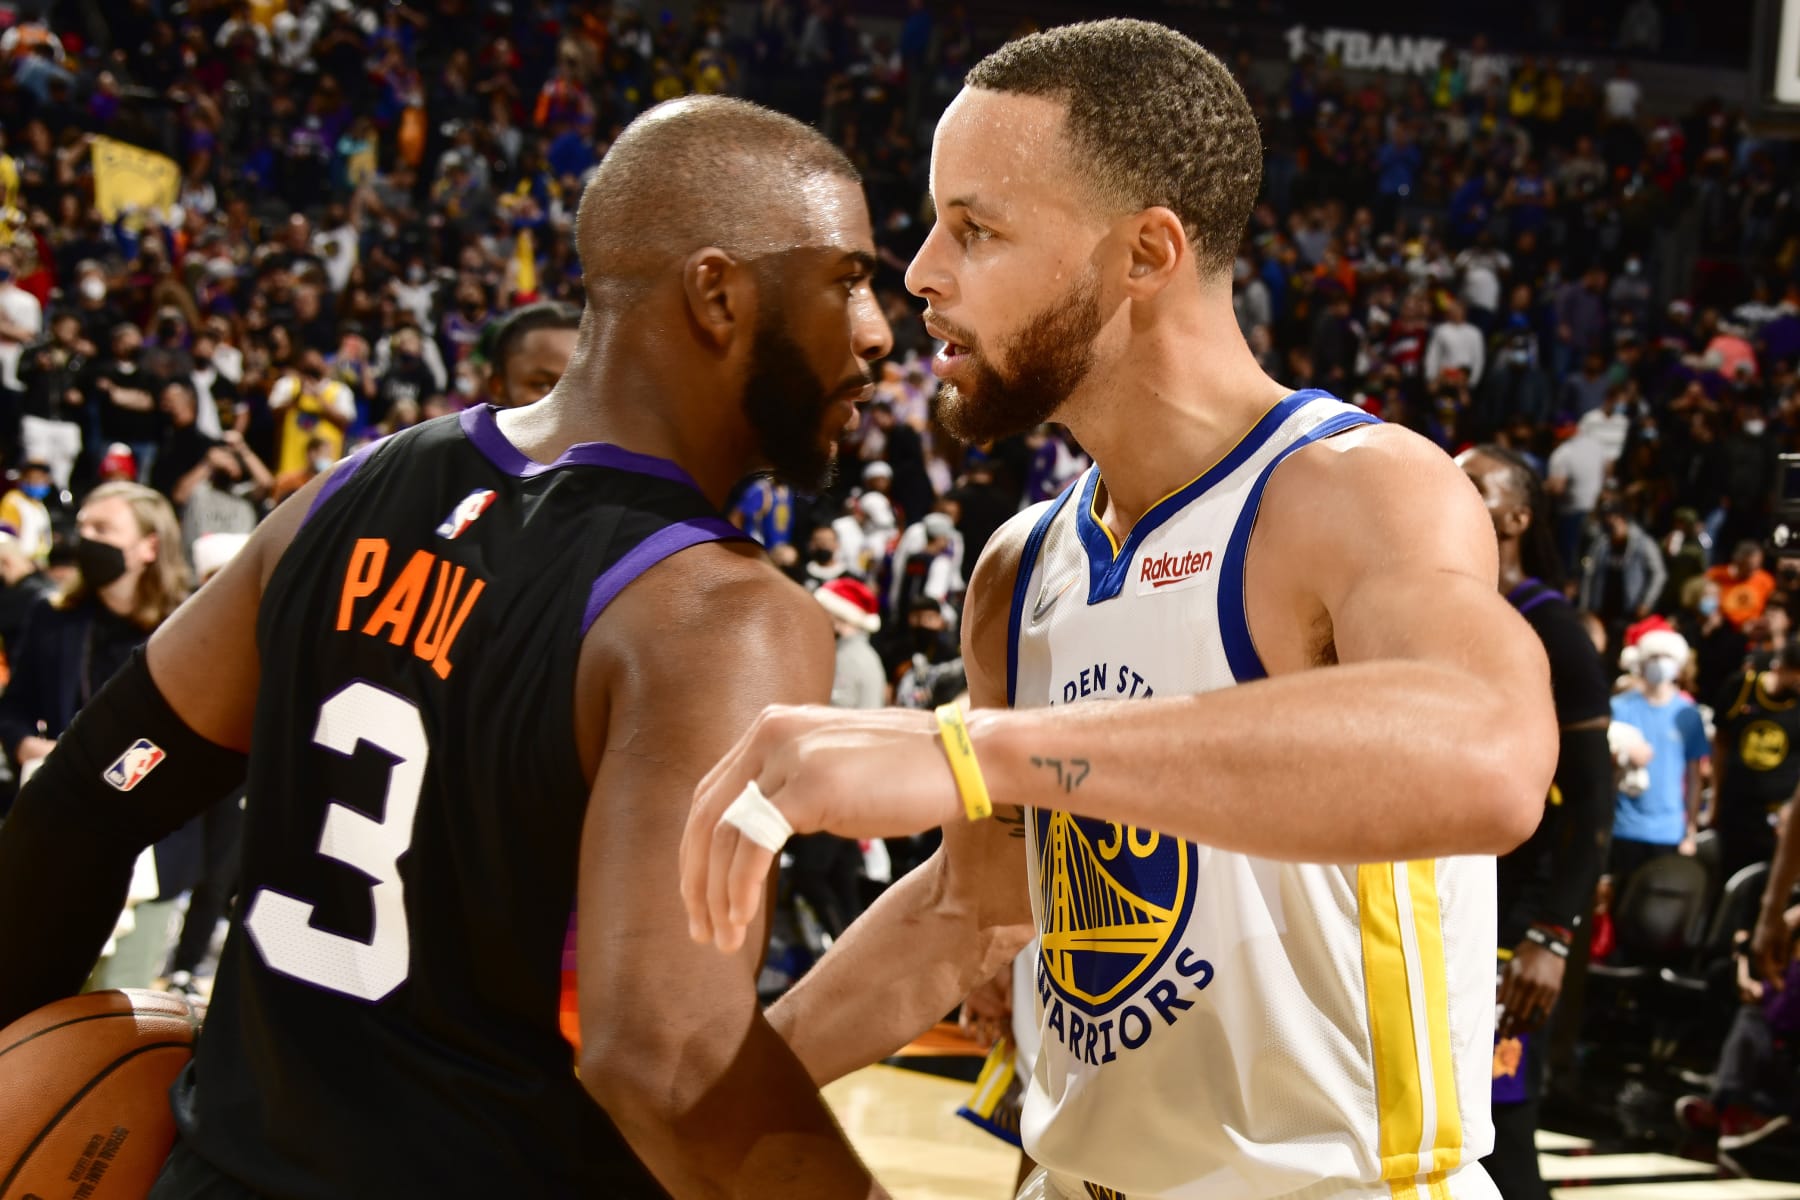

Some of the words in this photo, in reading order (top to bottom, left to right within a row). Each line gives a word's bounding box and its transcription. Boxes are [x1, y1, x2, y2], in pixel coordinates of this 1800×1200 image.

[336, 538, 487, 680] PAUL
[1140, 550, 1213, 585] Rakuten
[244, 679, 430, 1004] 3
[1037, 946, 1215, 1067] WARRIORS
